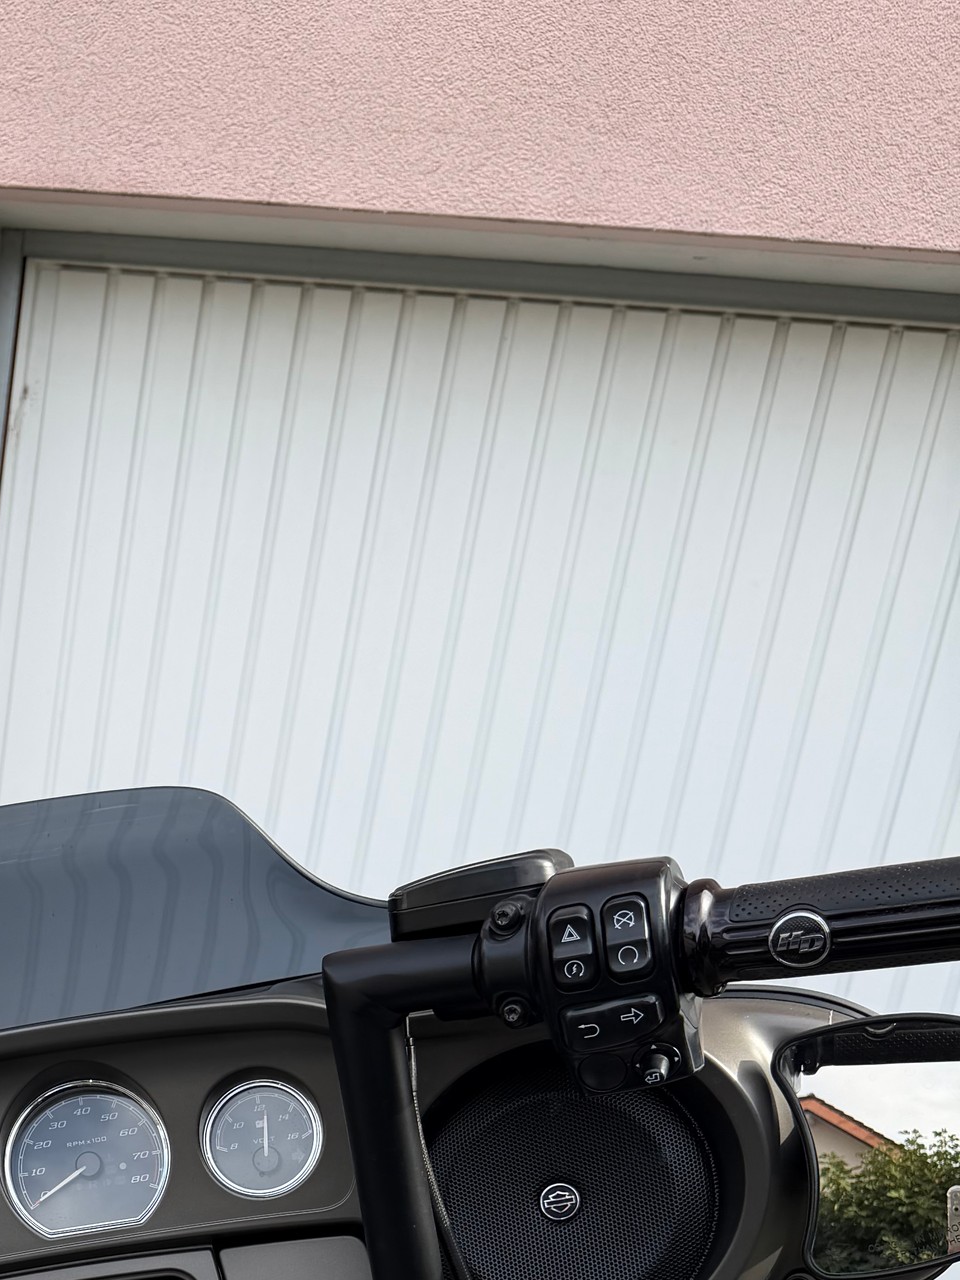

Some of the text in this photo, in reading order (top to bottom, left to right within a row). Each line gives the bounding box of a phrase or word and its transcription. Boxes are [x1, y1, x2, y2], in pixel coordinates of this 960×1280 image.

[73, 1107, 91, 1116] 40
[100, 1112, 118, 1122] 50
[48, 1120, 67, 1130] 30
[232, 1121, 244, 1129] 10
[119, 1127, 138, 1137] 60
[34, 1140, 52, 1150] 20
[132, 1151, 149, 1160] 70
[31, 1167, 46, 1177] 10
[130, 1174, 149, 1184] 80
